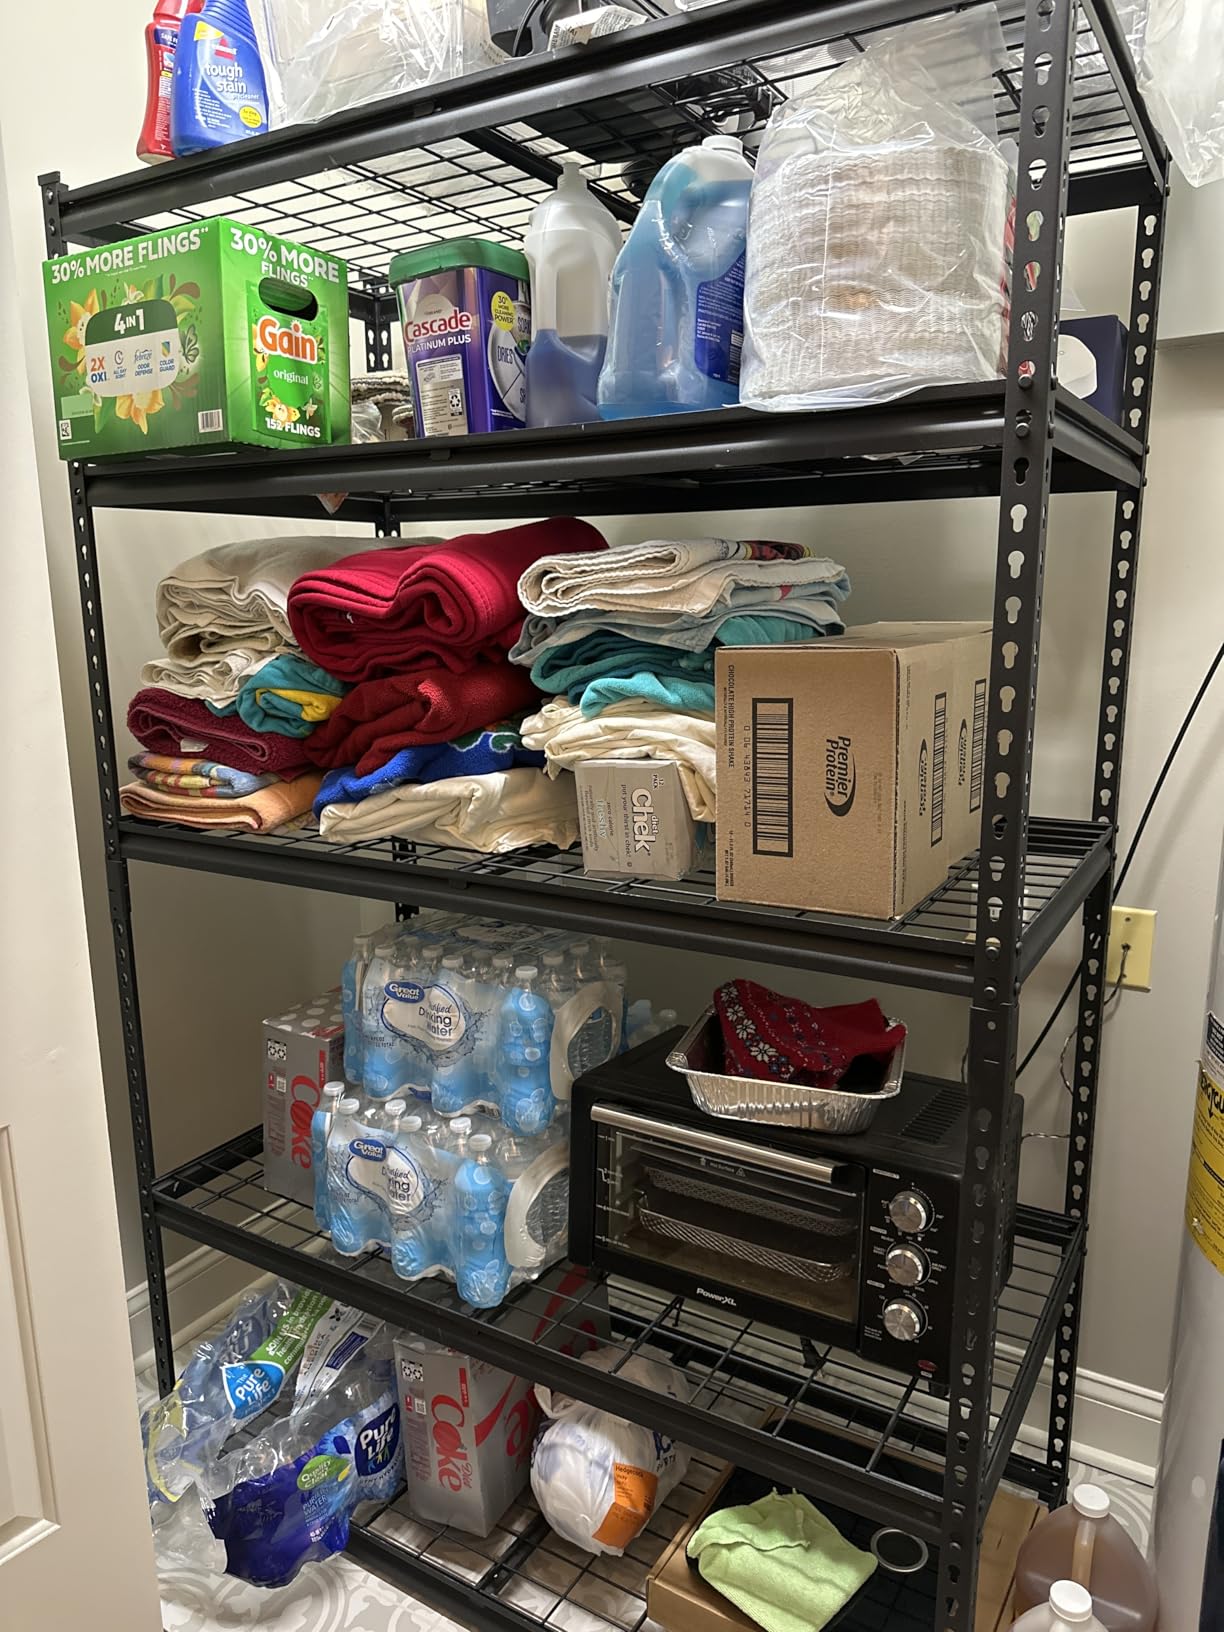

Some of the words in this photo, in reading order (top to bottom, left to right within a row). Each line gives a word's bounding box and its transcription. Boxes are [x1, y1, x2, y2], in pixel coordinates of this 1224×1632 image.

[205, 61, 243, 81] tough
[216, 79, 247, 94] stain
[51, 258, 85, 285] 30%
[85, 245, 134, 276] MORE
[230, 227, 277, 262] 30%
[280, 245, 339, 283] MORE
[405, 308, 472, 344] Cascade
[258, 317, 317, 363] Gain
[407, 338, 446, 354] PLATINUM
[447, 334, 472, 346] PLUS
[90, 355, 105, 372] 2X
[90, 371, 107, 384] OXI
[273, 368, 308, 385] original
[265, 416, 283, 431] 152
[284, 419, 321, 438] FLINGS
[825, 738, 838, 791] Protein
[837, 735, 851, 798] Premier
[658, 778, 664, 786] 12
[631, 788, 656, 853] Chek
[651, 815, 659, 835] diet
[389, 983, 420, 996] Great
[396, 992, 419, 1000] Value
[290, 1075, 321, 1169] Coke
[354, 1141, 384, 1154] Great
[361, 1150, 382, 1158] Value
[696, 1287, 737, 1306] PowerXL
[234, 1366, 266, 1402] Pure
[247, 1380, 272, 1405] Life
[360, 1409, 396, 1450] Pure
[367, 1428, 393, 1460] Life
[431, 1394, 468, 1493] Coke
